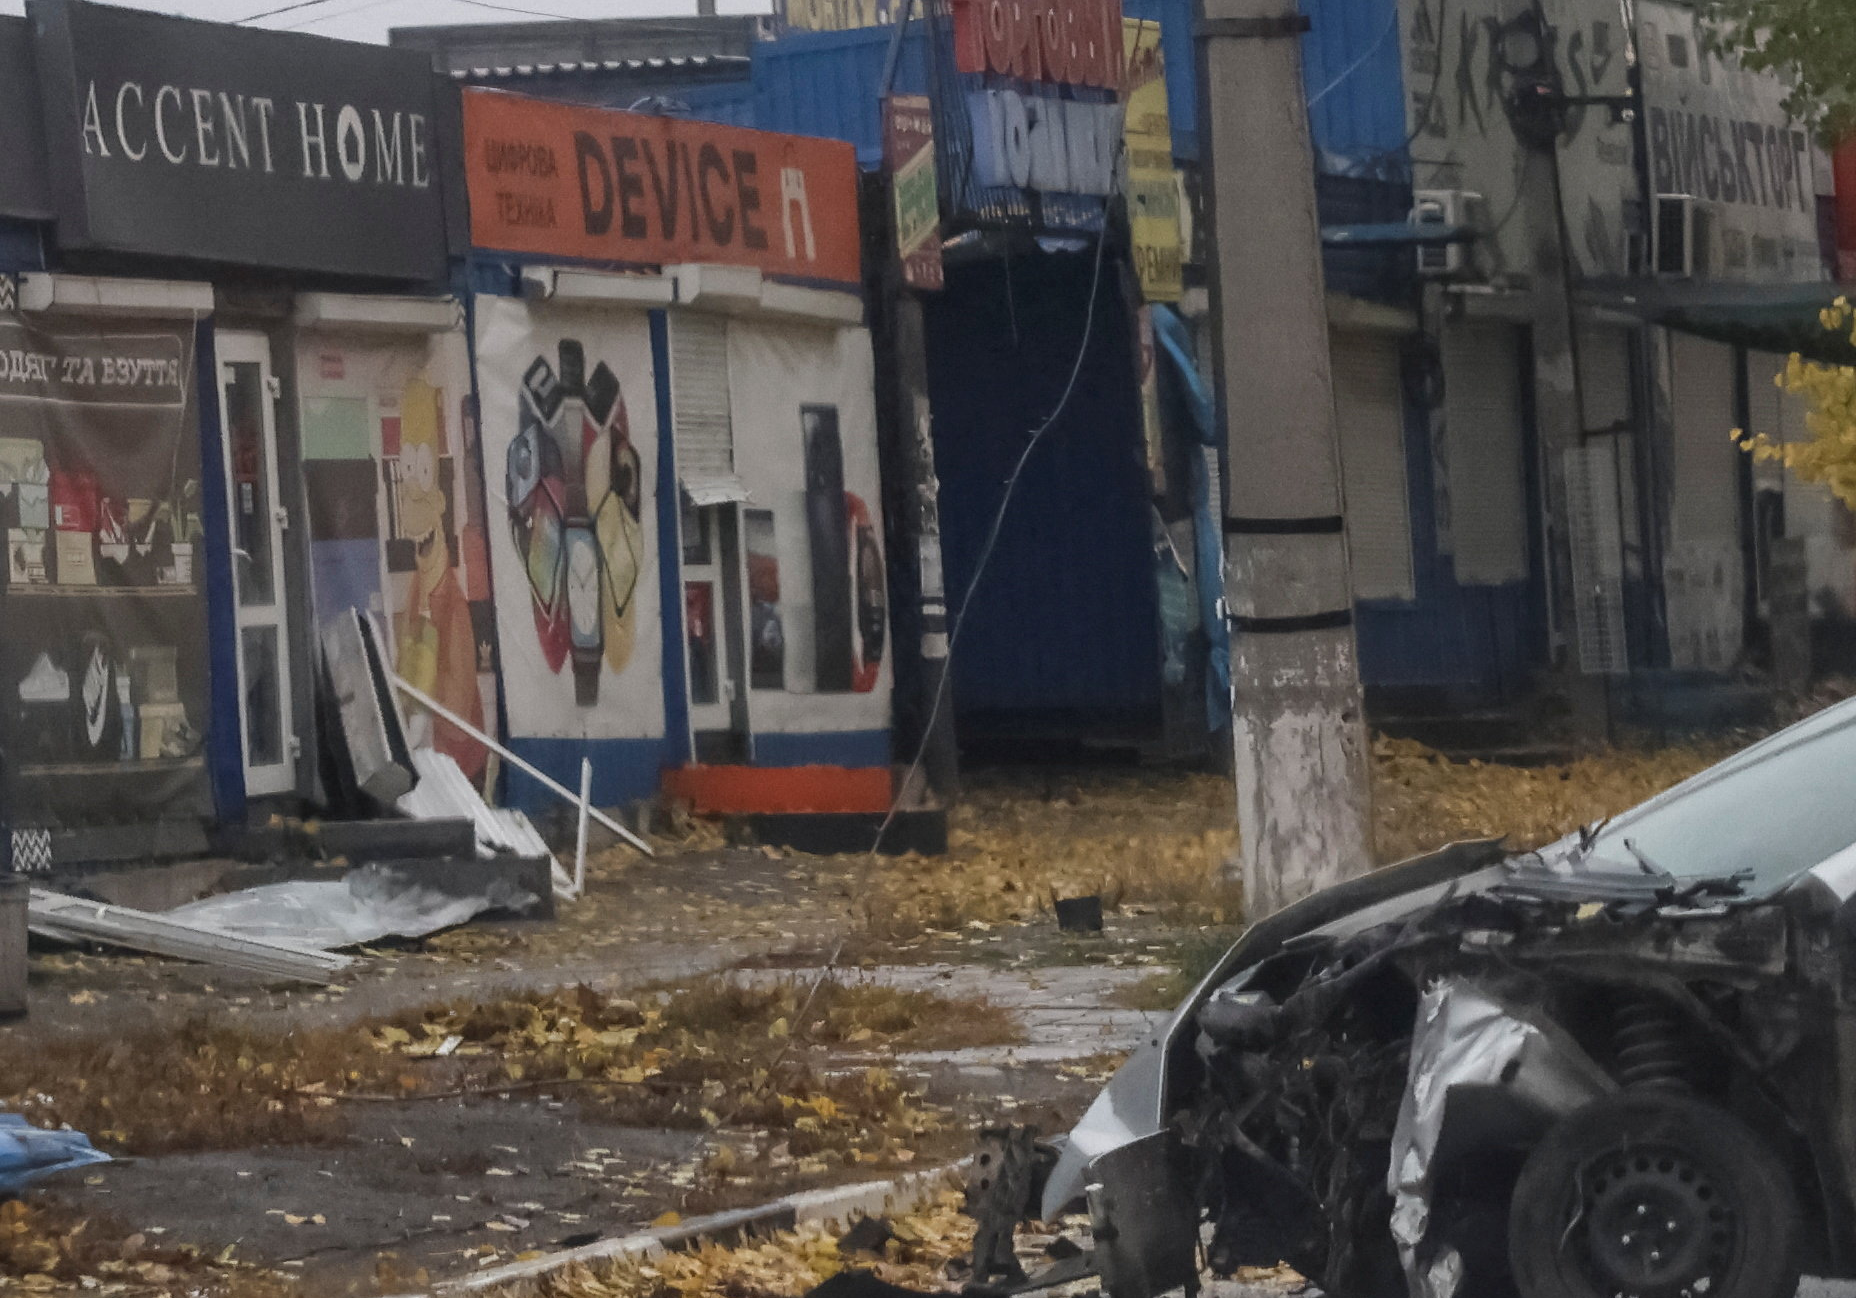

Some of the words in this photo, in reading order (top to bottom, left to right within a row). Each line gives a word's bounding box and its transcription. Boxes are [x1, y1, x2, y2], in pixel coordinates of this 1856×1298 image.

[82, 80, 274, 174] ACCENT
[296, 100, 431, 189] HOME
[484, 138, 559, 179] ЦИФРОВА
[573, 130, 769, 250] DEVICE
[60, 355, 96, 386] ТА
[100, 356, 180, 387] ВЗУТТЯ
